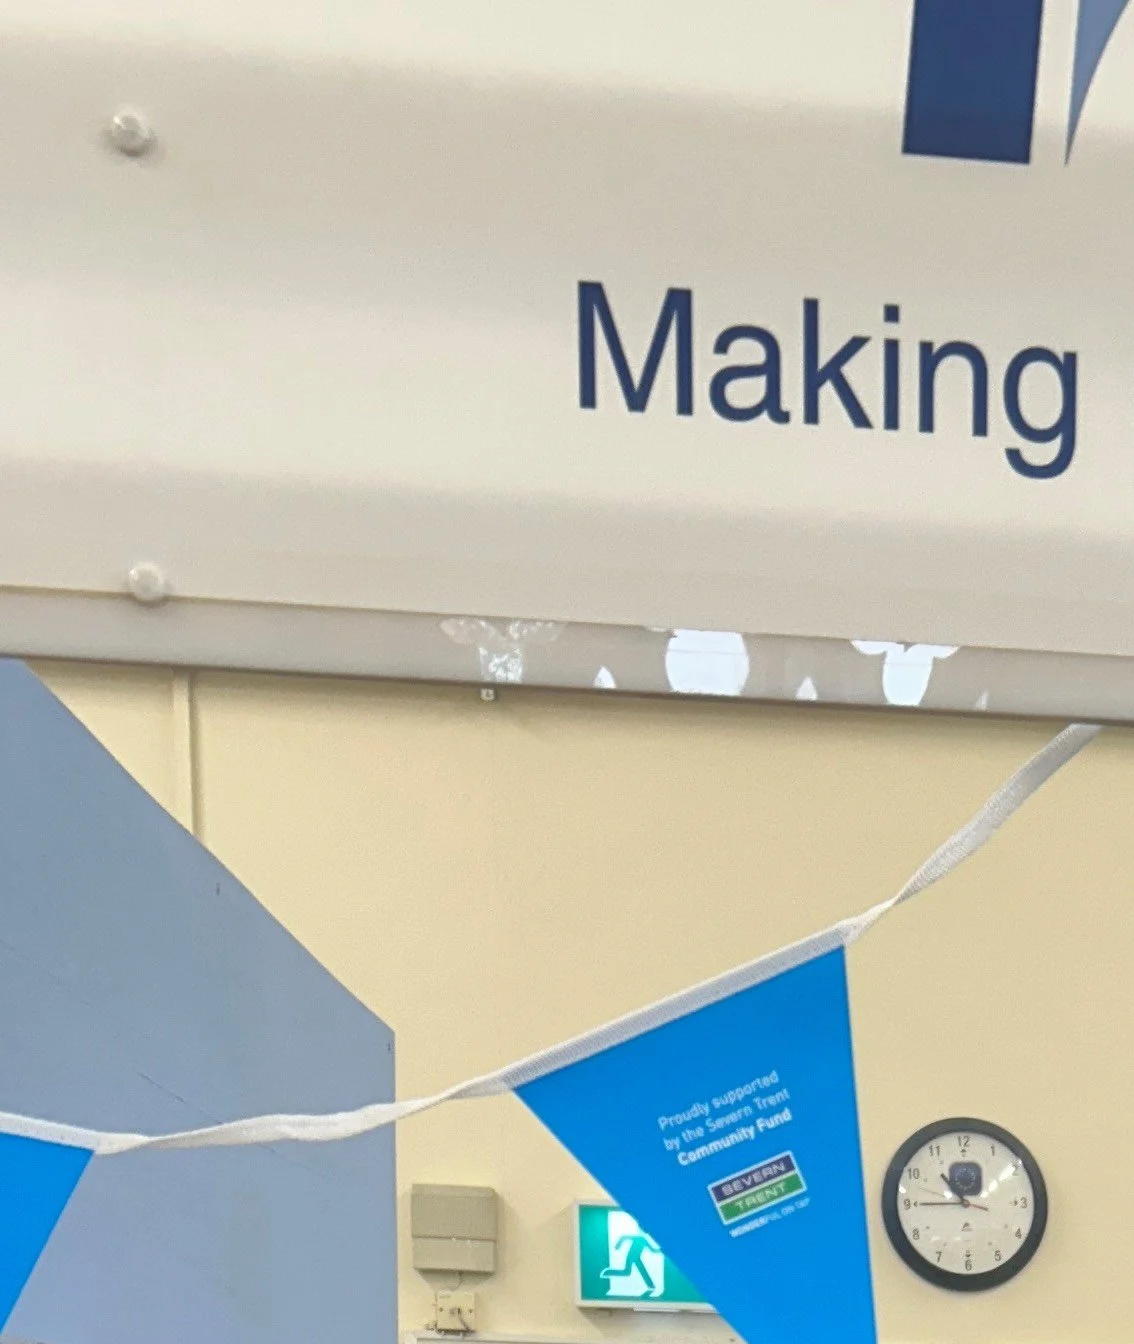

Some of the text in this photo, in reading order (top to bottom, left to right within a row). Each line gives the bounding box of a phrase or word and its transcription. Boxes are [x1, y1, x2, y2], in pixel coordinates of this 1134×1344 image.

[576, 281, 1079, 478] Making
[658, 1070, 779, 1130] Proudly supported
[663, 1088, 791, 1151] by the Severn Trent
[677, 1107, 793, 1166] Community Fund
[956, 1136, 970, 1148] 12
[928, 1145, 941, 1156] 11
[721, 1160, 786, 1196] SEVERN
[907, 1168, 920, 1179] 10
[735, 1181, 786, 1210] TRENT
[903, 1199, 911, 1210] 9
[1020, 1197, 1028, 1208] 3
[912, 1229, 920, 1240] 8
[1015, 1228, 1022, 1239] 4
[936, 1252, 942, 1263] 7
[994, 1251, 1002, 1261] 5
[965, 1260, 972, 1271] 6
